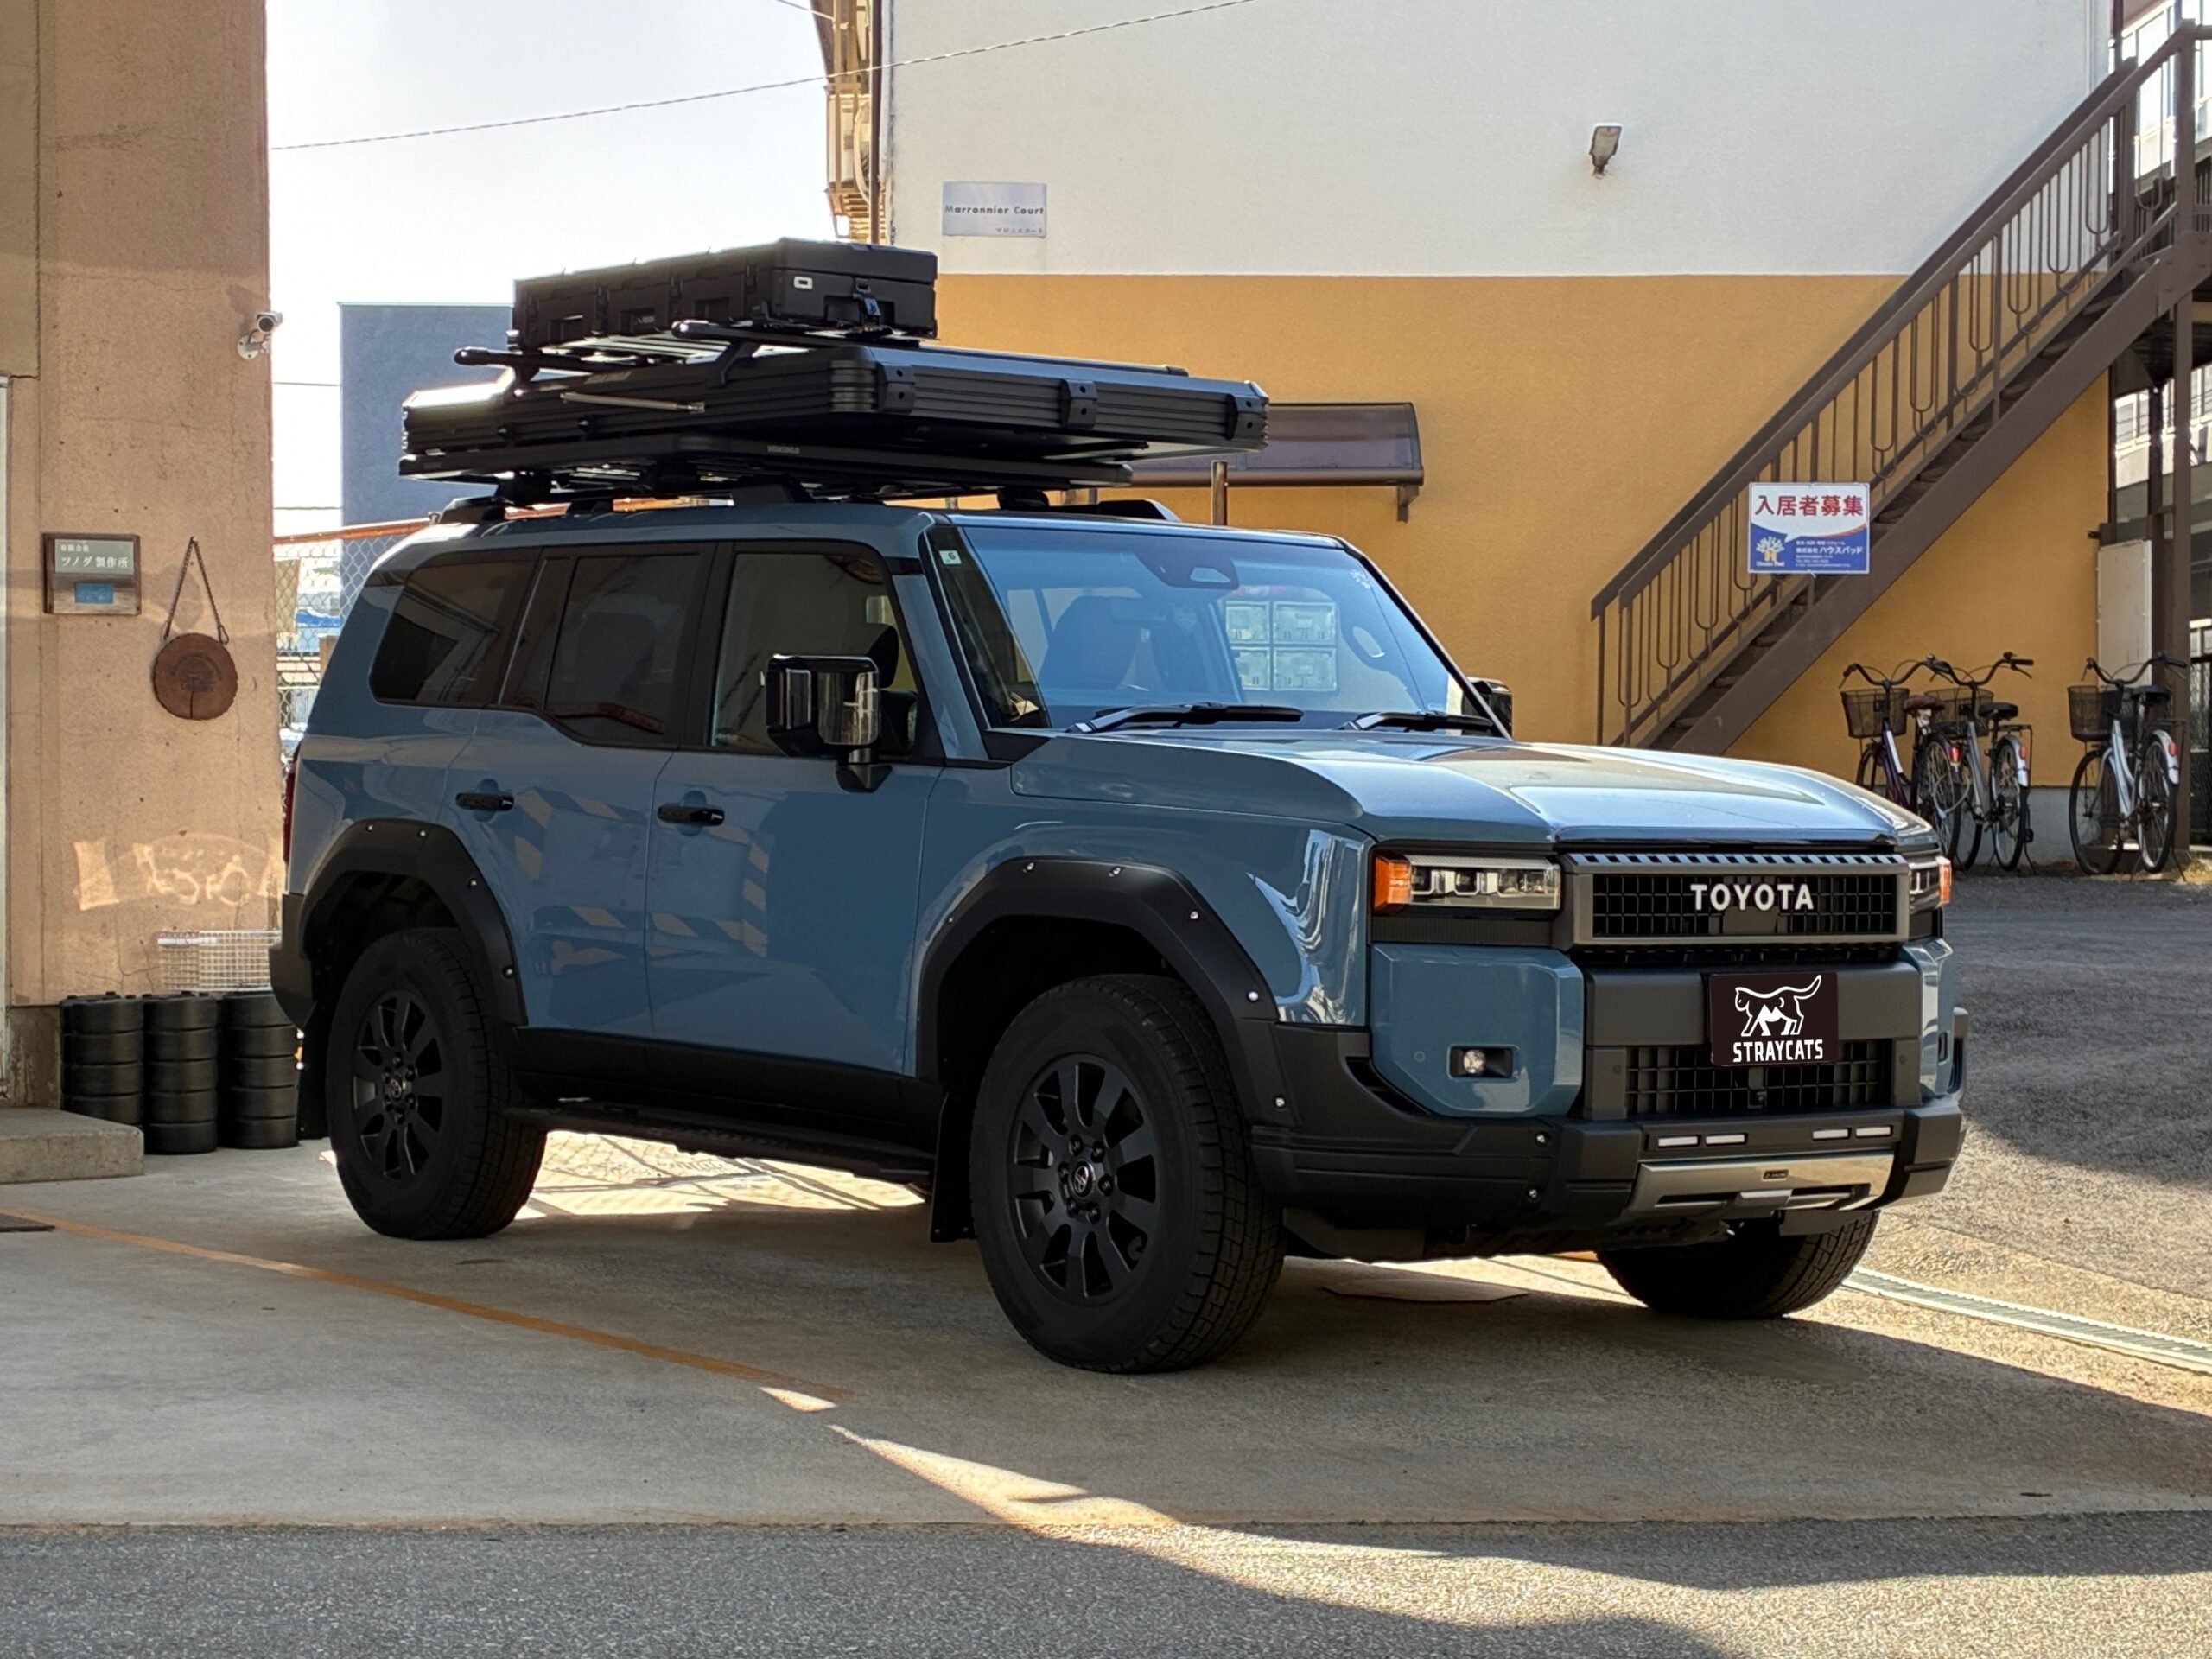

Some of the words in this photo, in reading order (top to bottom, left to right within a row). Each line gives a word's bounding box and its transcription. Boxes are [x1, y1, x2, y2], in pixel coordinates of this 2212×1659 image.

[944, 205, 1009, 214] Marronnier
[1014, 205, 1044, 215] Court
[1755, 494, 1864, 517] 入居者募集
[1690, 883, 1815, 911] TOYOTA
[1732, 1039, 1823, 1063] STRAYCATS
